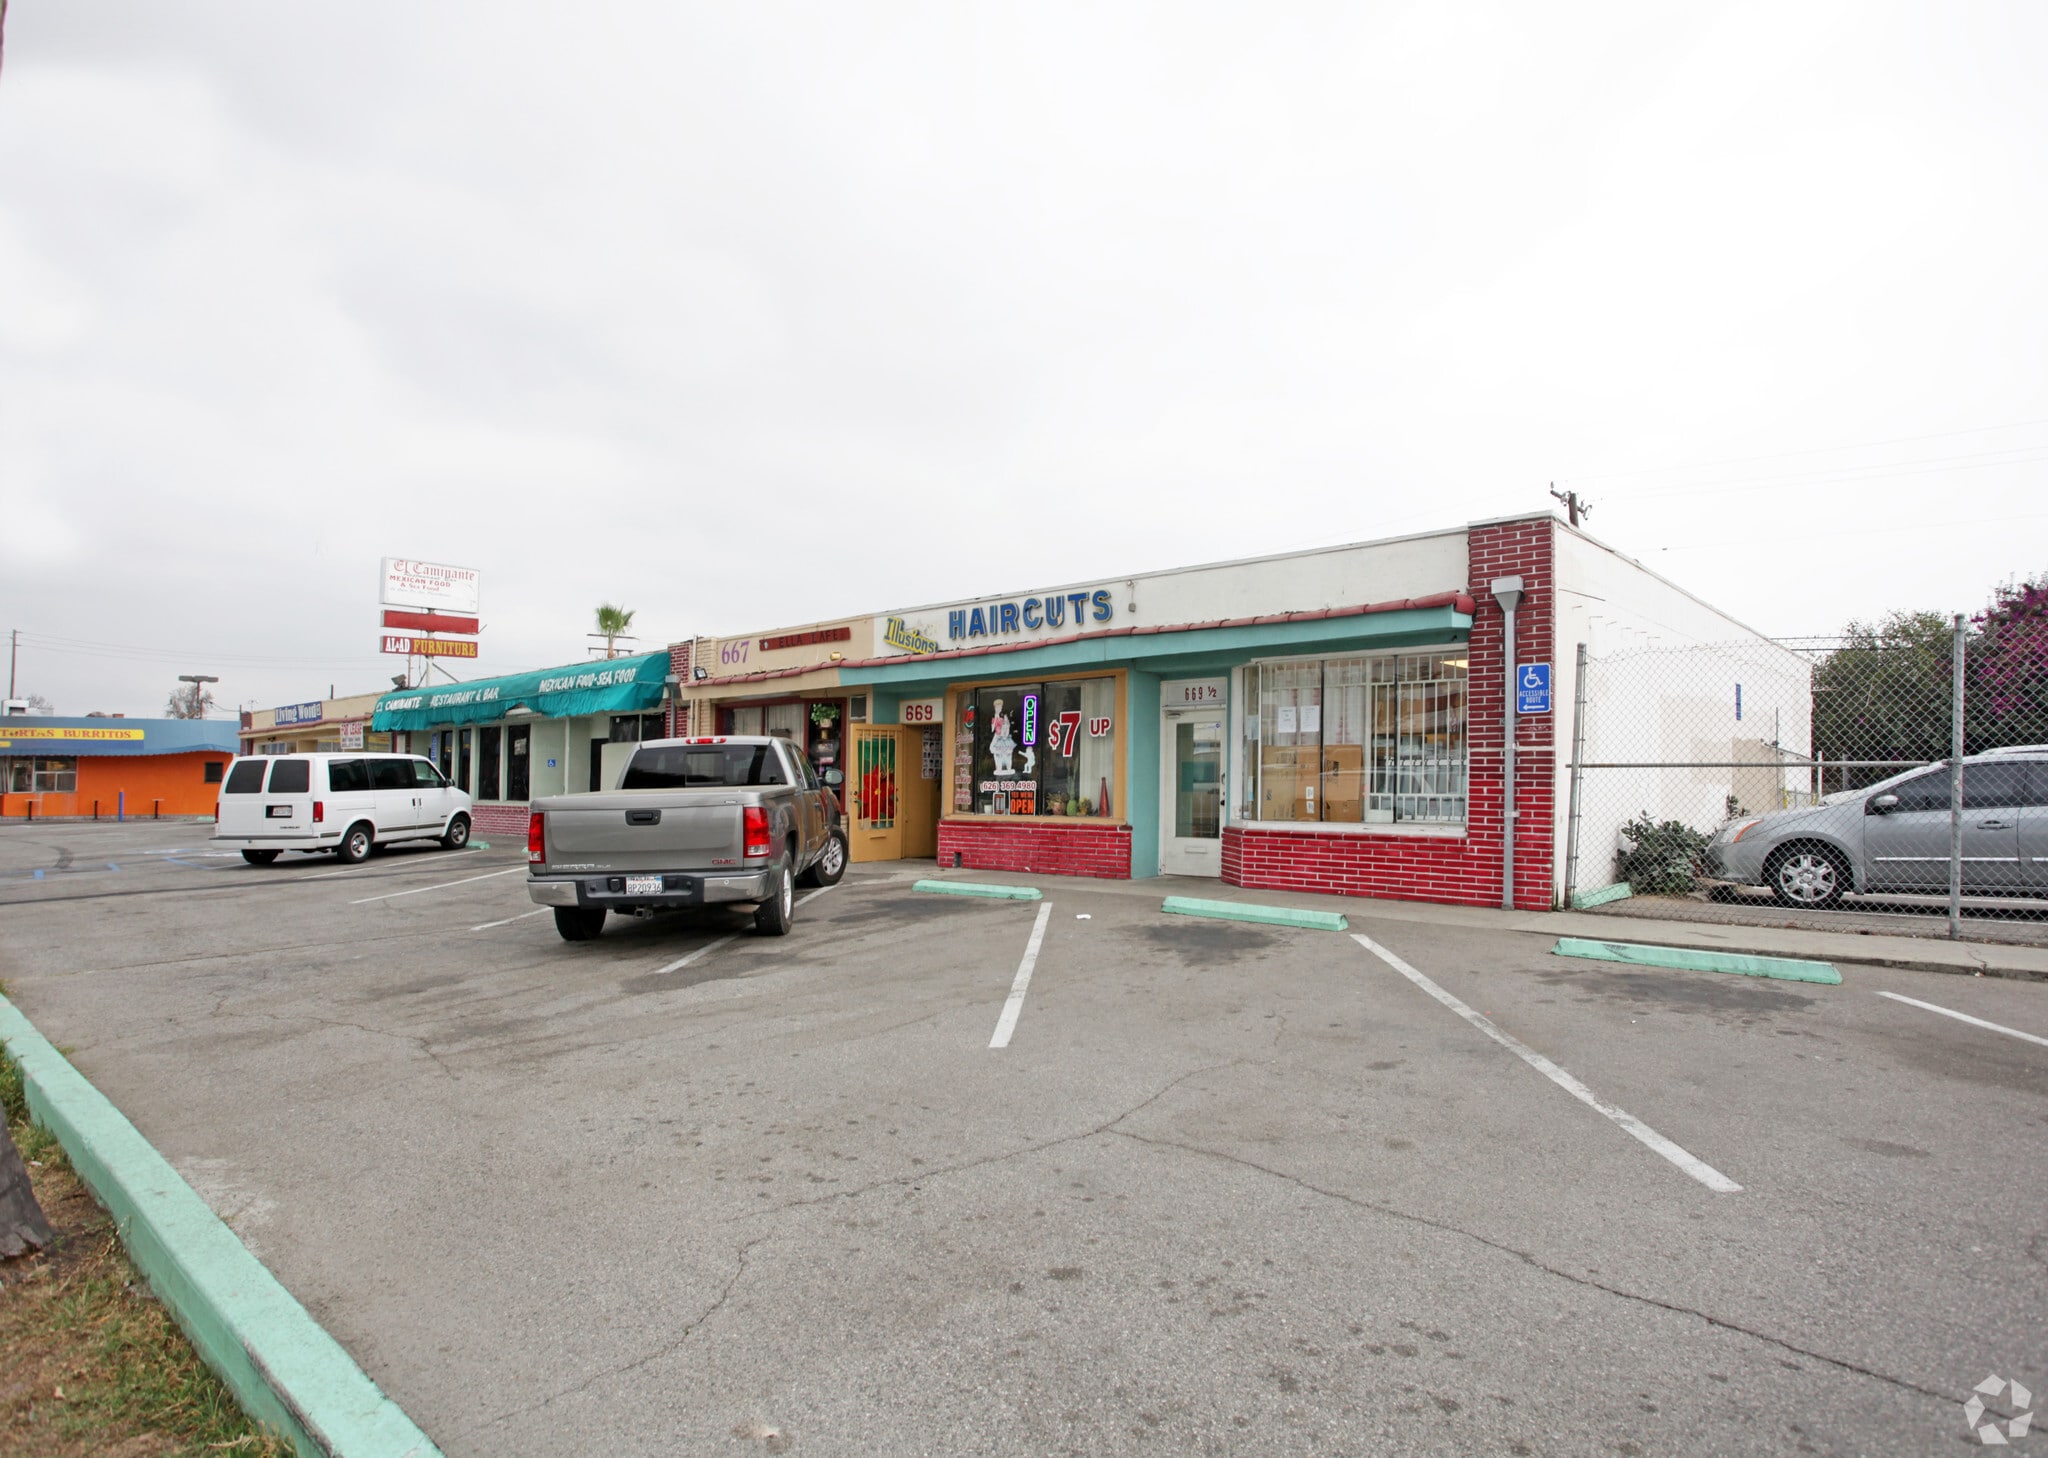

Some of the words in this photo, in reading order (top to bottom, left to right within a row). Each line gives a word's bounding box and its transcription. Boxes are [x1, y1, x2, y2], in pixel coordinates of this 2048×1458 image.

[389, 575, 426, 584] MEXICAN
[429, 580, 451, 588] FOOD
[949, 590, 1113, 640] HAIRCUTS
[884, 617, 938, 654] Illusions
[413, 639, 476, 657] FURNITURE
[721, 640, 750, 665] 667
[539, 675, 576, 692] MEXICAN
[613, 668, 636, 684] FOOD
[430, 691, 476, 707] RESTAURANT
[475, 689, 482, 701] &
[482, 687, 500, 701] BAR
[1185, 686, 1203, 701] 669
[1519, 689, 1549, 697] ACCESSIBLE
[275, 706, 298, 722] Living
[298, 703, 317, 719] Word
[905, 704, 933, 721] 669
[1025, 698, 1035, 742] OPEN
[63, 729, 131, 739] BURRITOS
[1089, 717, 1111, 737] UP
[1016, 781, 1037, 791] 4980
[1010, 799, 1034, 814] OPEN
[712, 858, 737, 866] GMC
